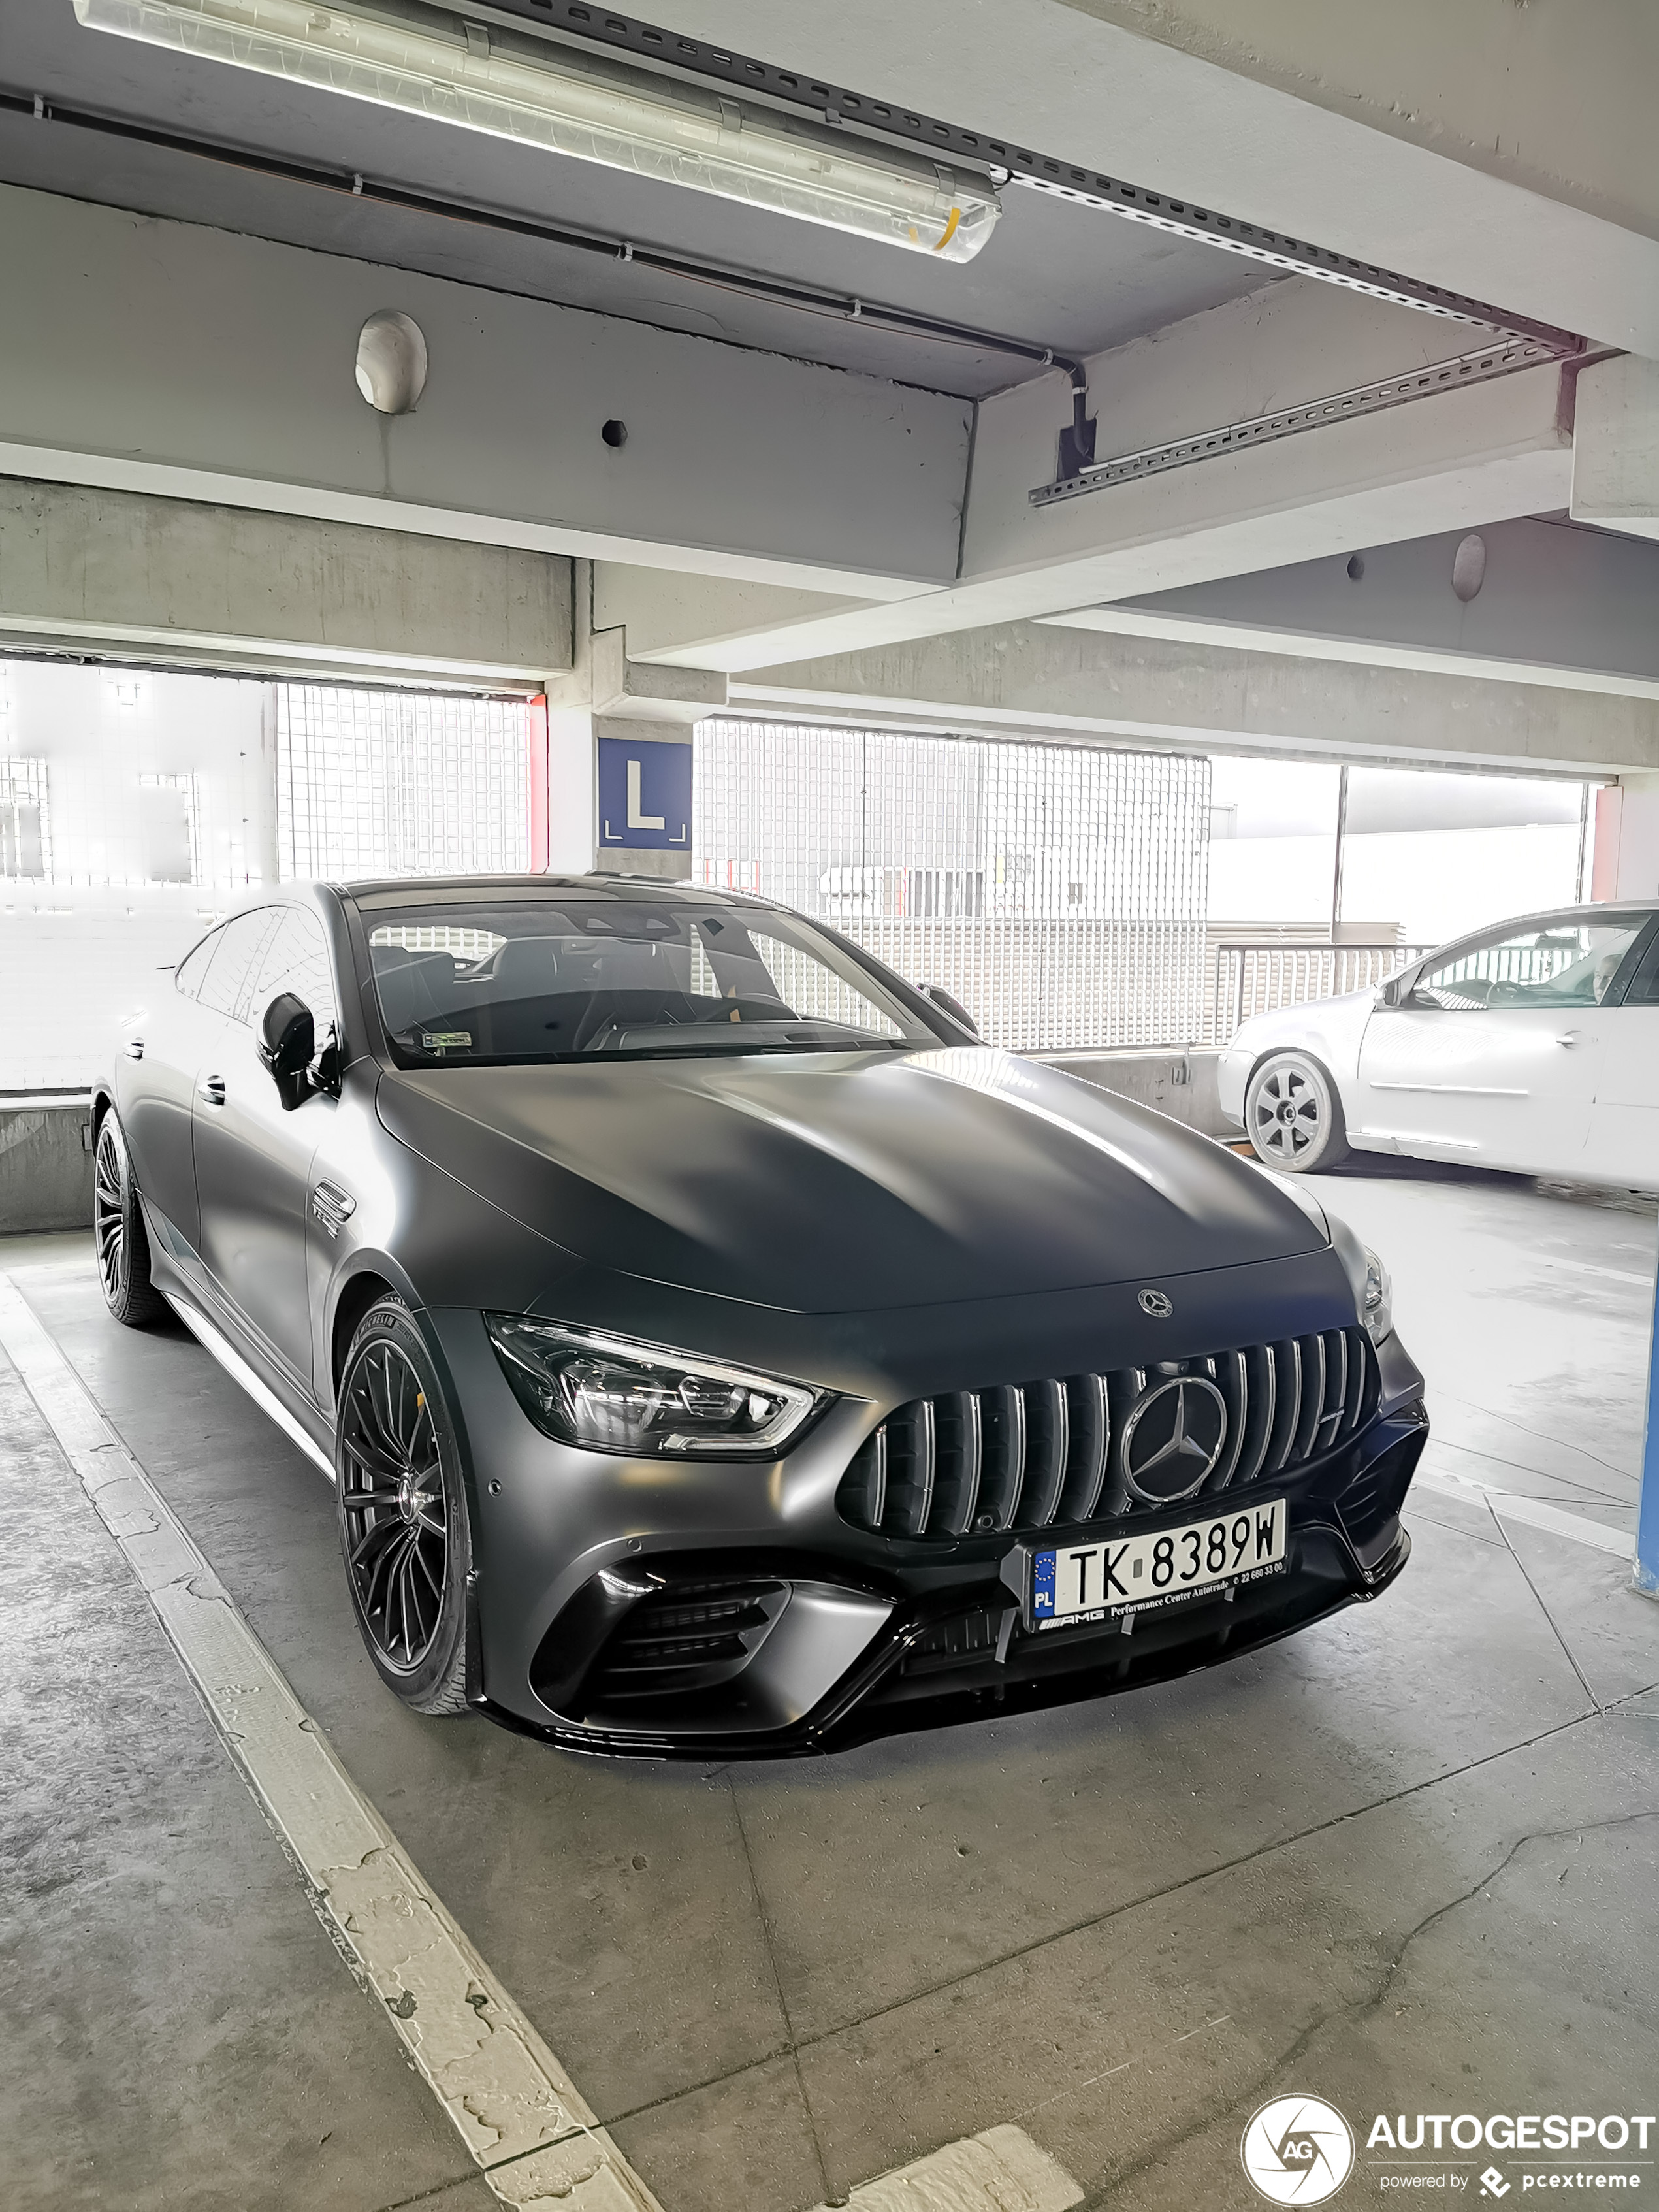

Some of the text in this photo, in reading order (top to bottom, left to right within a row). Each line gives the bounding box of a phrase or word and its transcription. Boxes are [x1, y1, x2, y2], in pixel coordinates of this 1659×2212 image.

[627, 760, 665, 830] L
[1069, 1506, 1275, 1605] TK 8389W
[1035, 1591, 1053, 1609] PL
[1056, 1561, 1283, 1627] AMG Performance Center Autotrade 22 660 33 00
